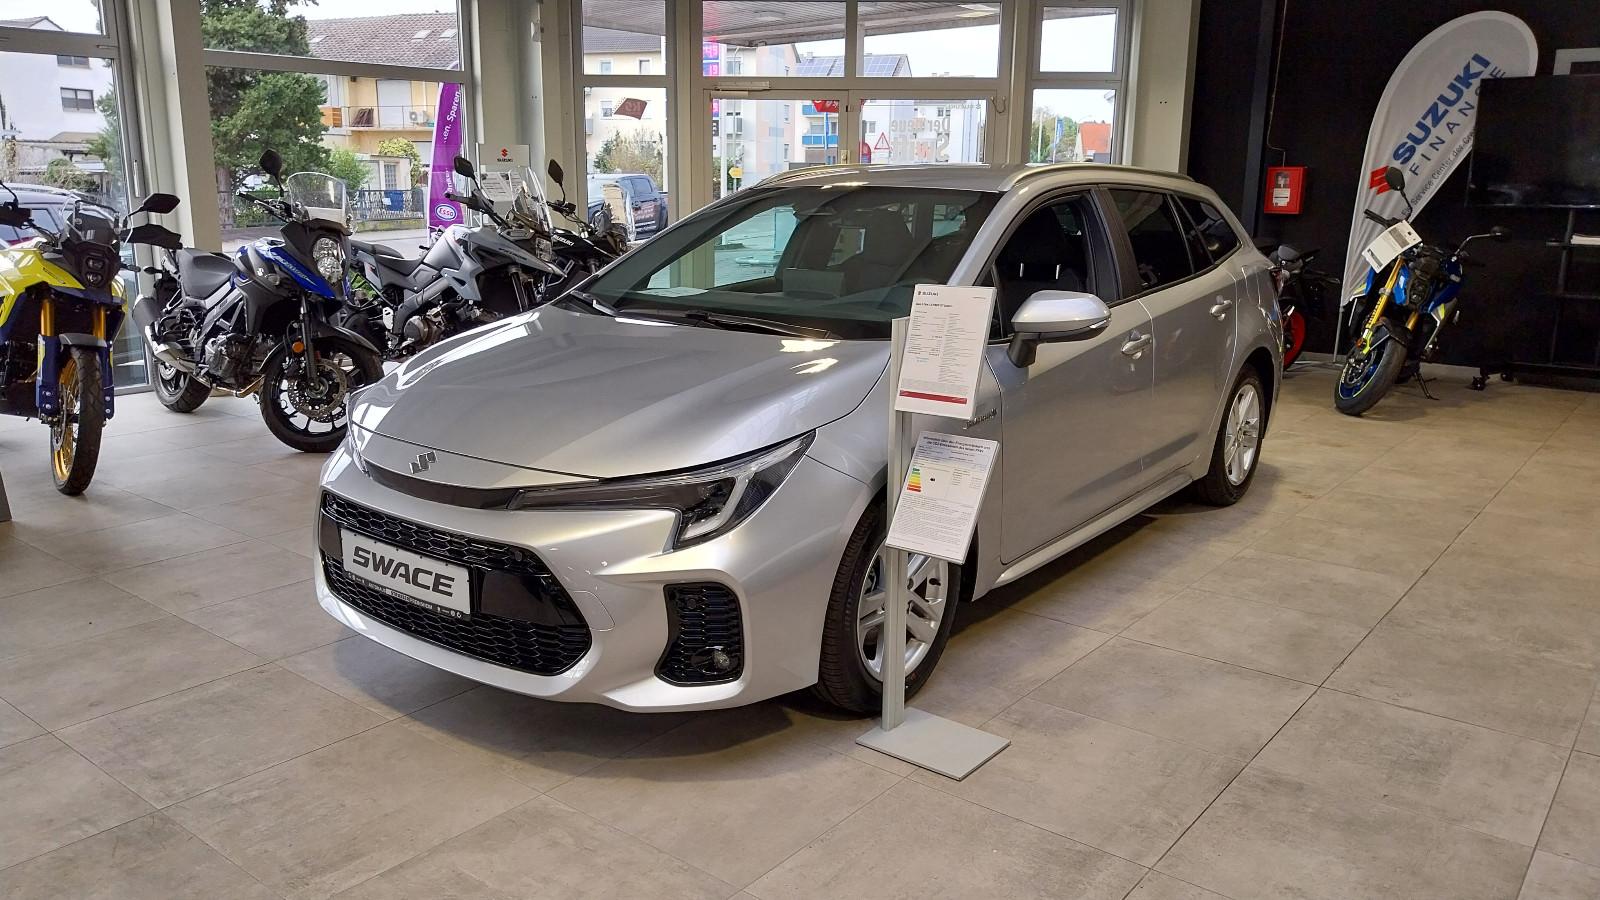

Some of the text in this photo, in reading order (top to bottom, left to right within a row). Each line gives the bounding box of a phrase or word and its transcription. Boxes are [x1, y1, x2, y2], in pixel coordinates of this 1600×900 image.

[1393, 53, 1491, 165] SUZUKI
[552, 234, 575, 247] SUZUKI
[352, 545, 456, 598] SWACE
